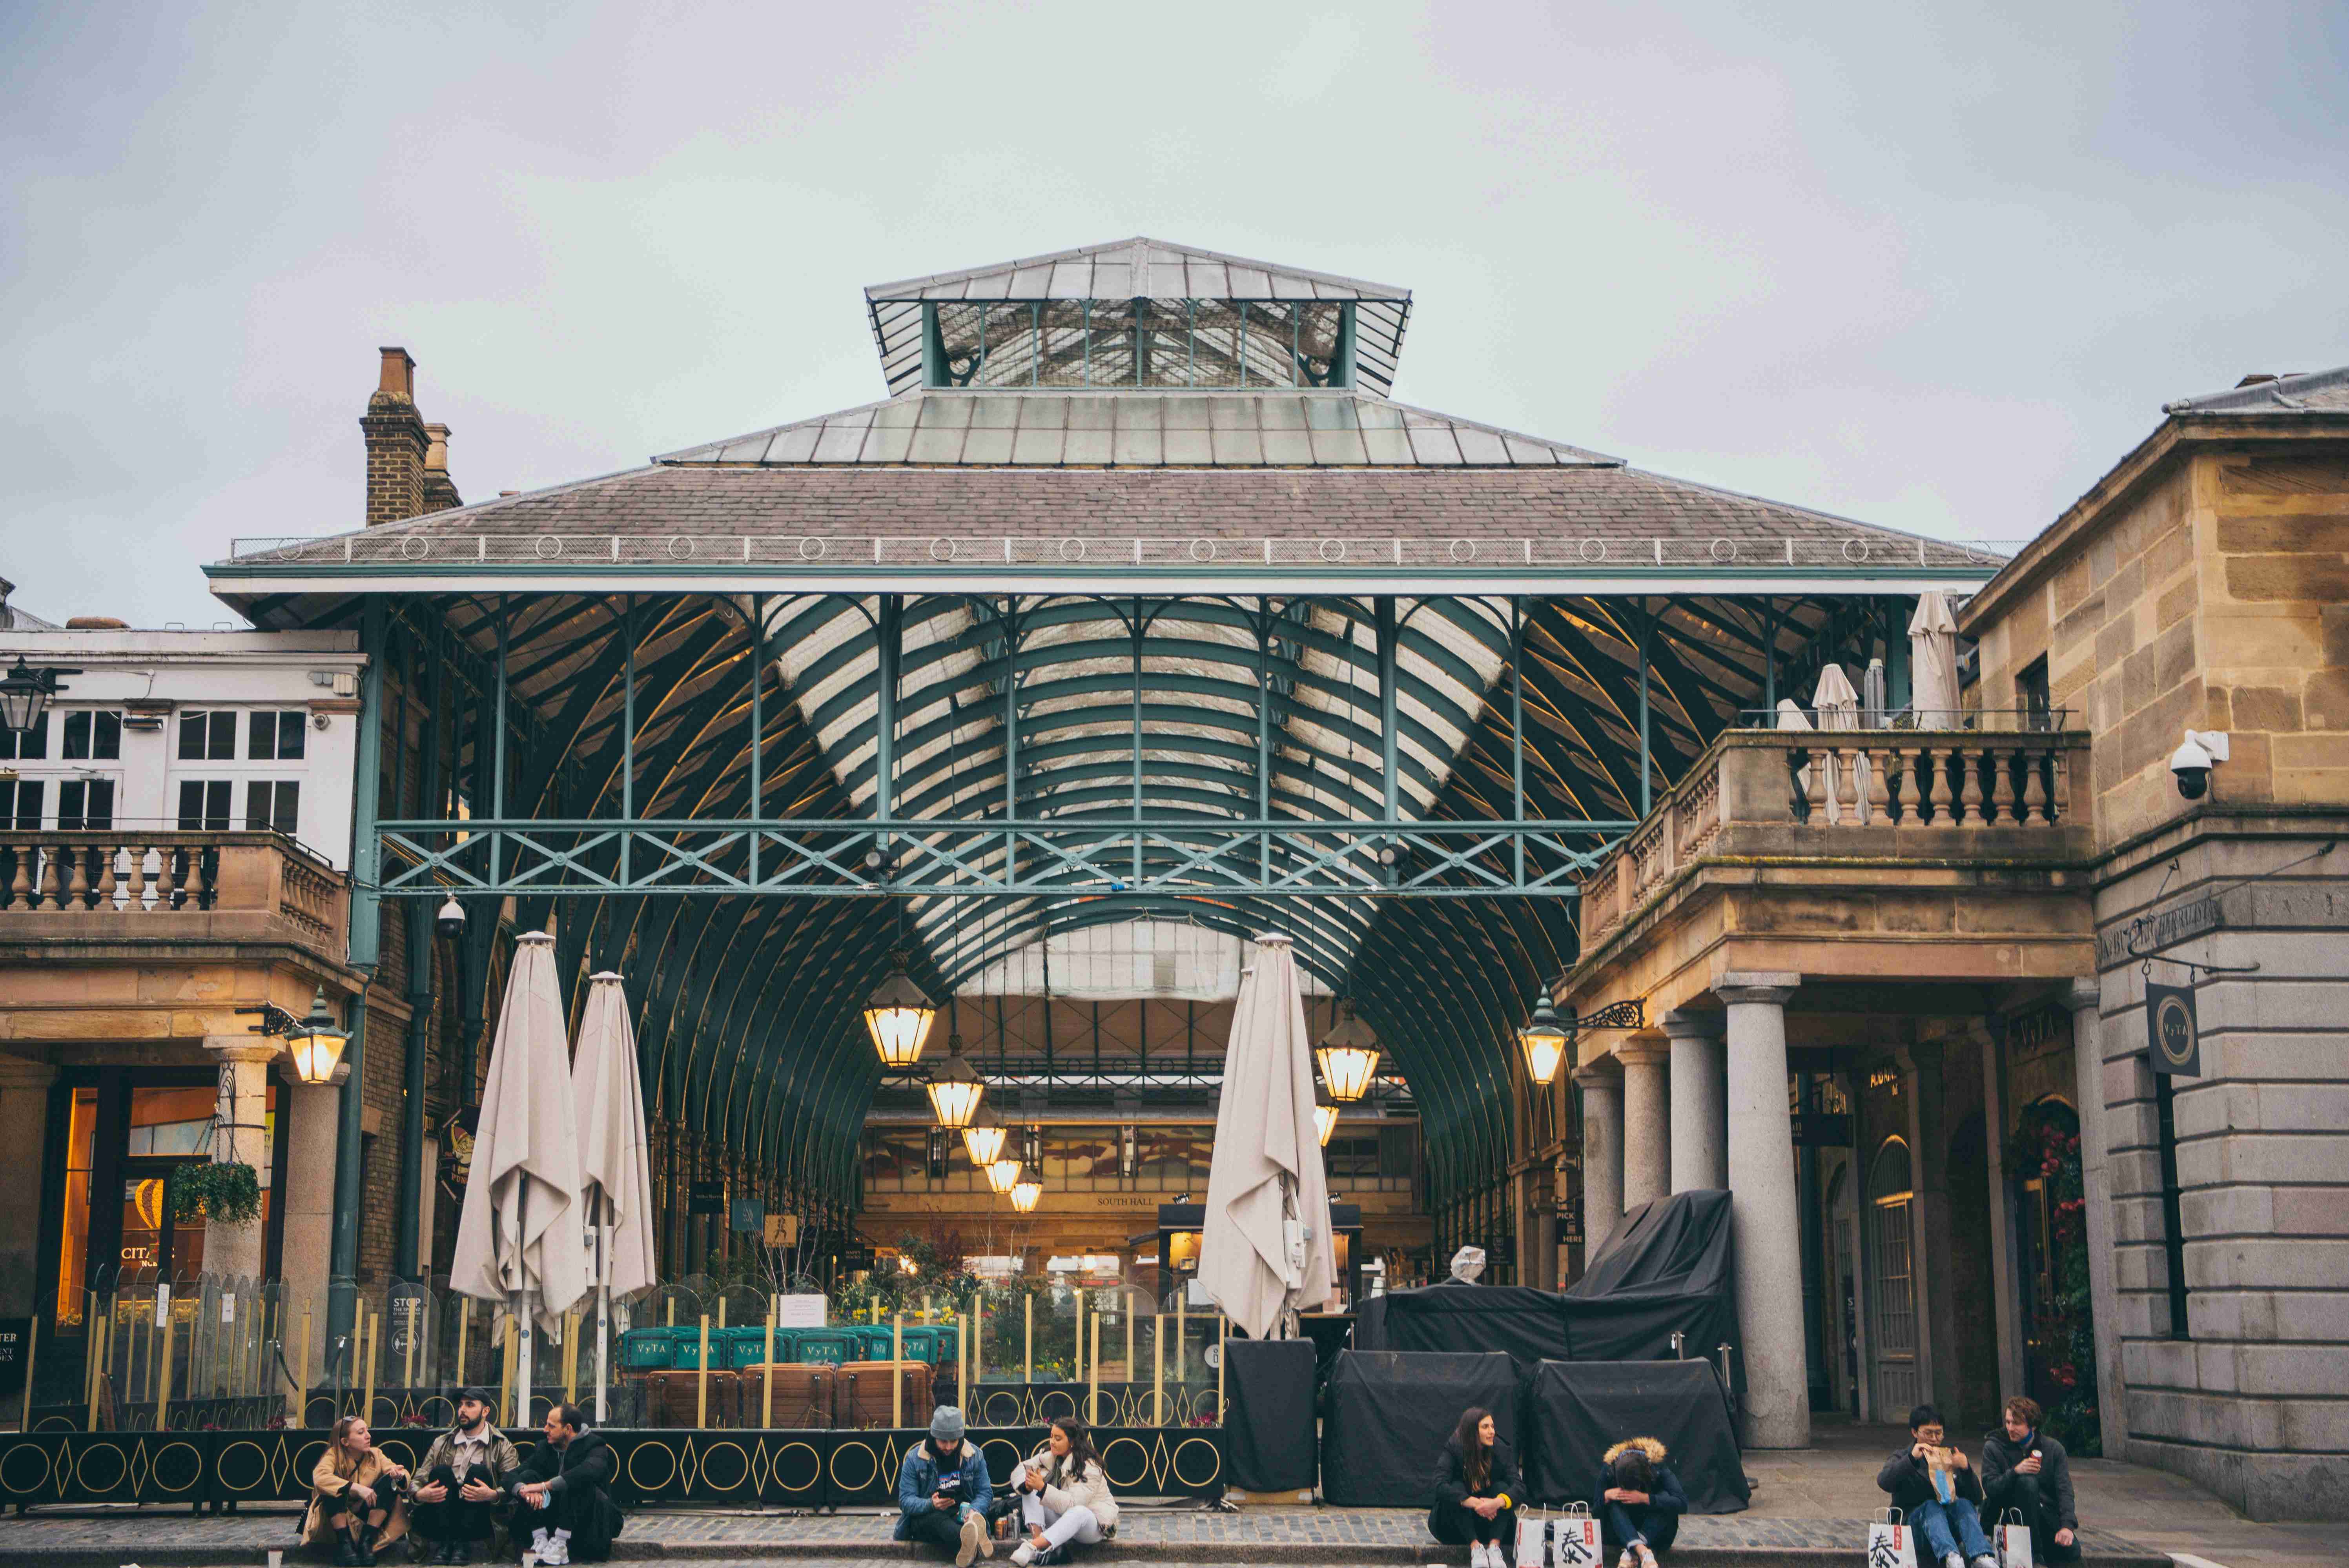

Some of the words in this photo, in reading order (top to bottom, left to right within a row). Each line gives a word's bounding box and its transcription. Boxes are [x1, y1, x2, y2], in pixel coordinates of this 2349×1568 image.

[2163, 1023, 2188, 1036] VyTA
[637, 1344, 666, 1354] VyTA
[683, 1345, 714, 1355] VyA
[806, 1346, 838, 1356] VyTA
[907, 1341, 924, 1352] yTA
